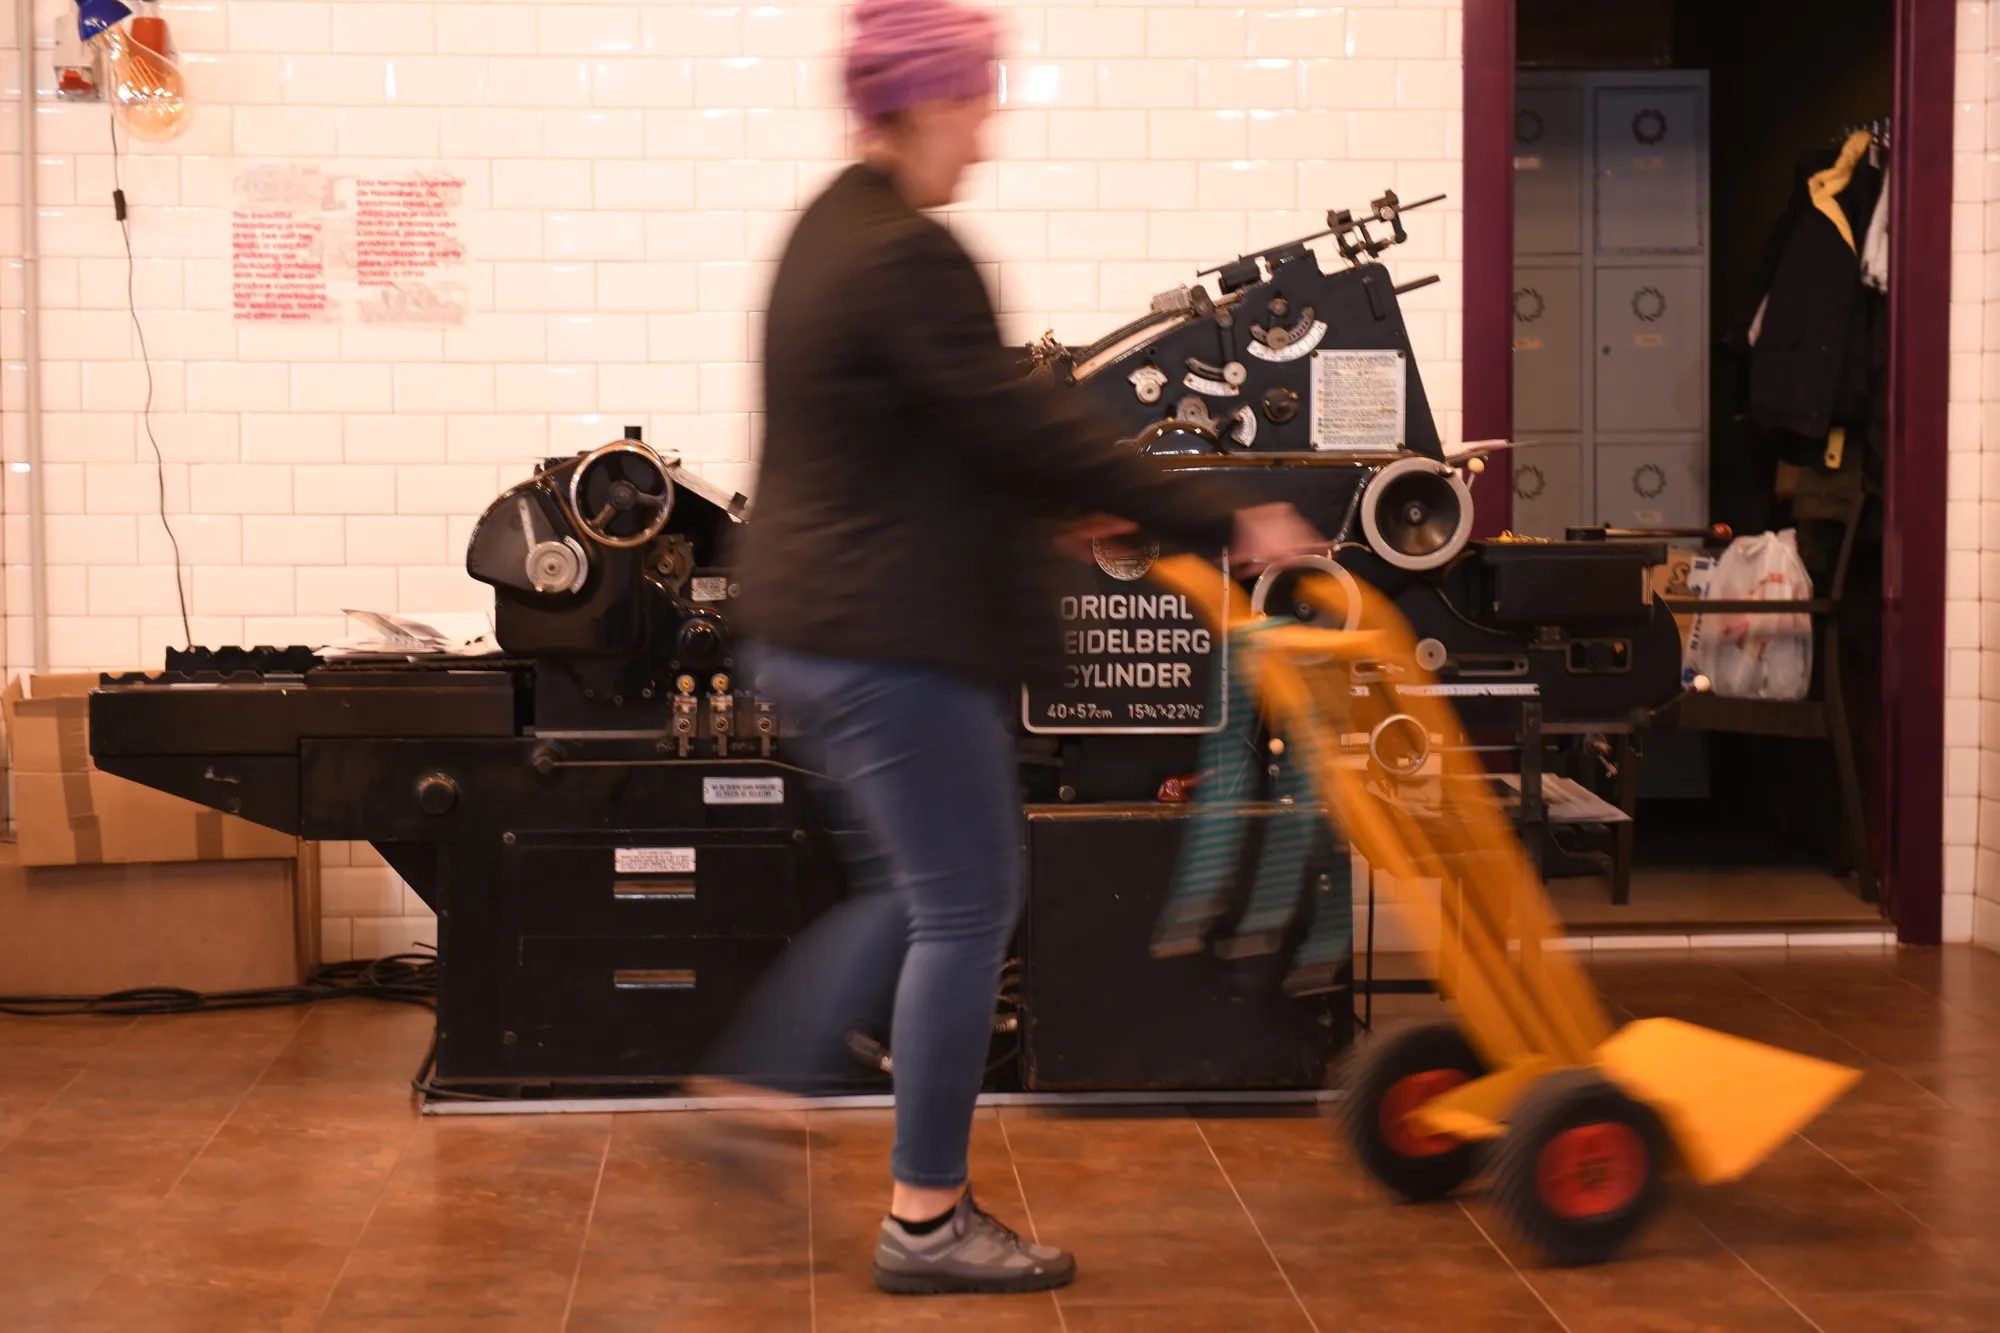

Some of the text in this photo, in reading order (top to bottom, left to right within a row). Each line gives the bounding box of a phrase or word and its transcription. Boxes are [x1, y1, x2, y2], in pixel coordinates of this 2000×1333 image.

[1060, 594, 1194, 620] ORIGINAL
[1063, 628, 1211, 654] EIDELBERG
[1063, 662, 1192, 689] CYLINDER
